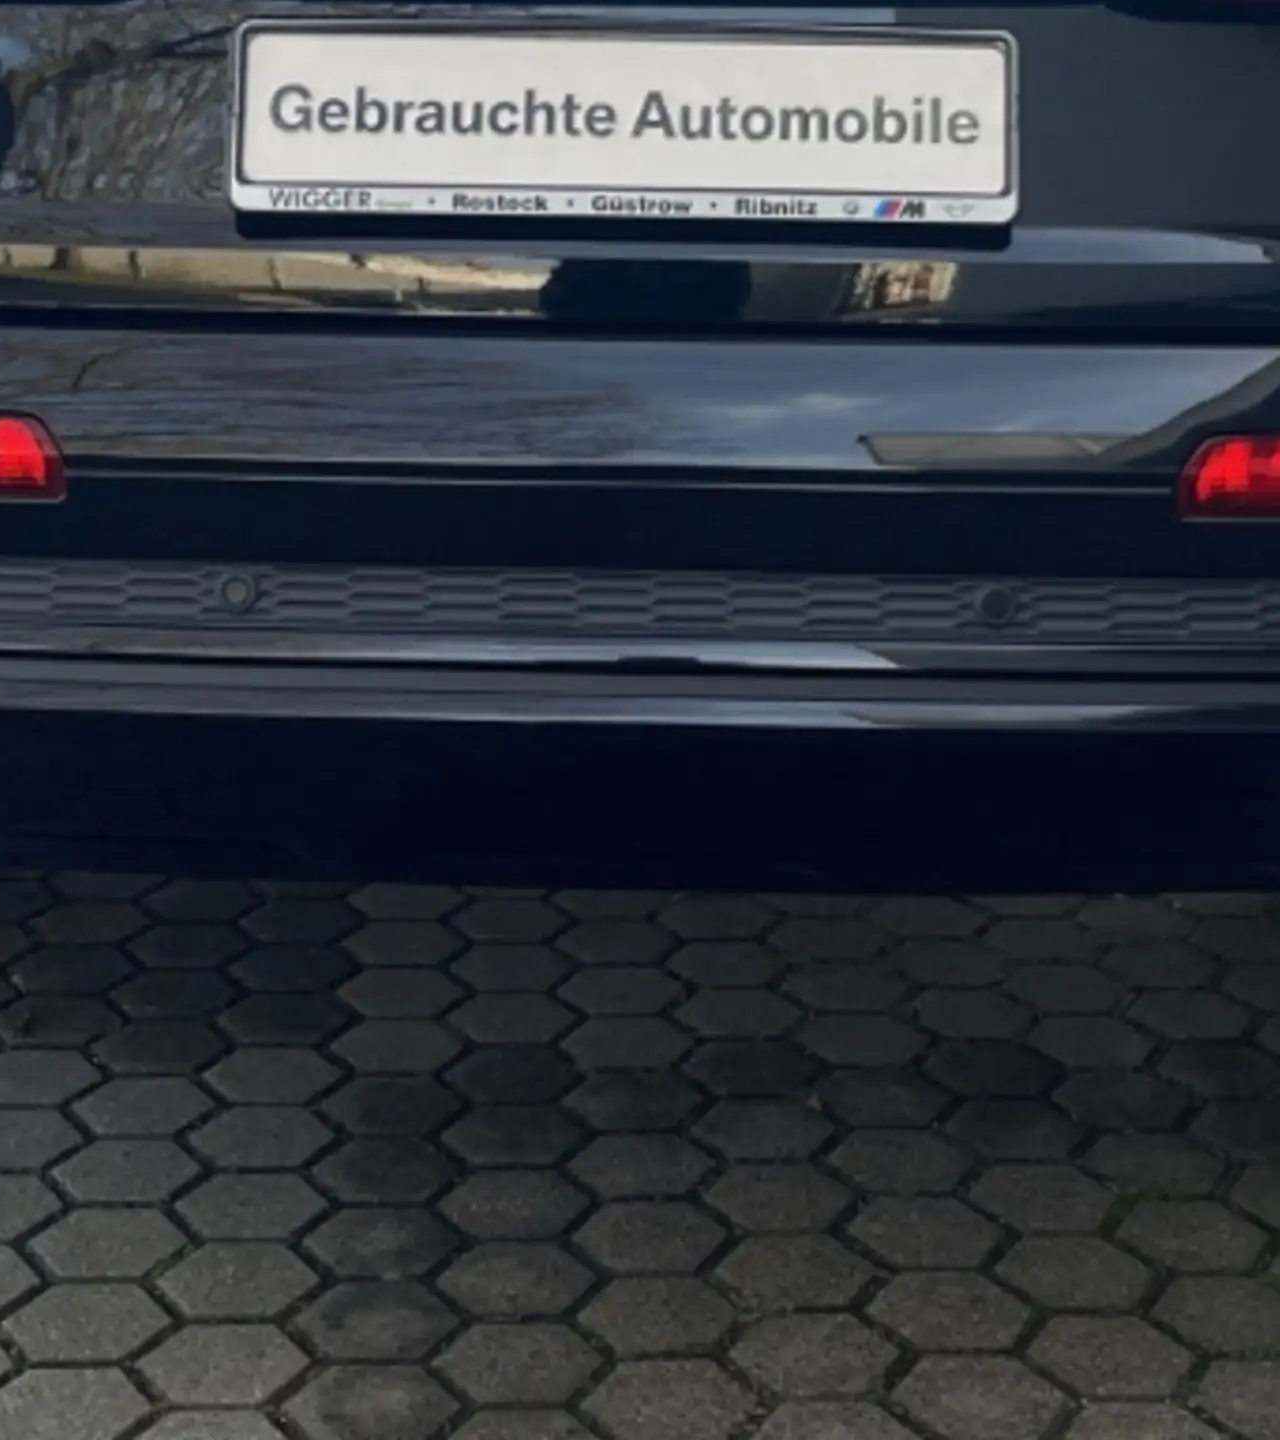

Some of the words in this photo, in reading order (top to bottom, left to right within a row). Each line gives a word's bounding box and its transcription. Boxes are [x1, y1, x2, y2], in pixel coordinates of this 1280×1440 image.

[269, 84, 617, 137] Gebrauchte
[630, 89, 981, 145] Automobile
[269, 187, 373, 209] WIGGER
[452, 192, 549, 212] Rostock
[591, 195, 693, 216] Güstrow
[734, 197, 818, 217] Ribnitz
